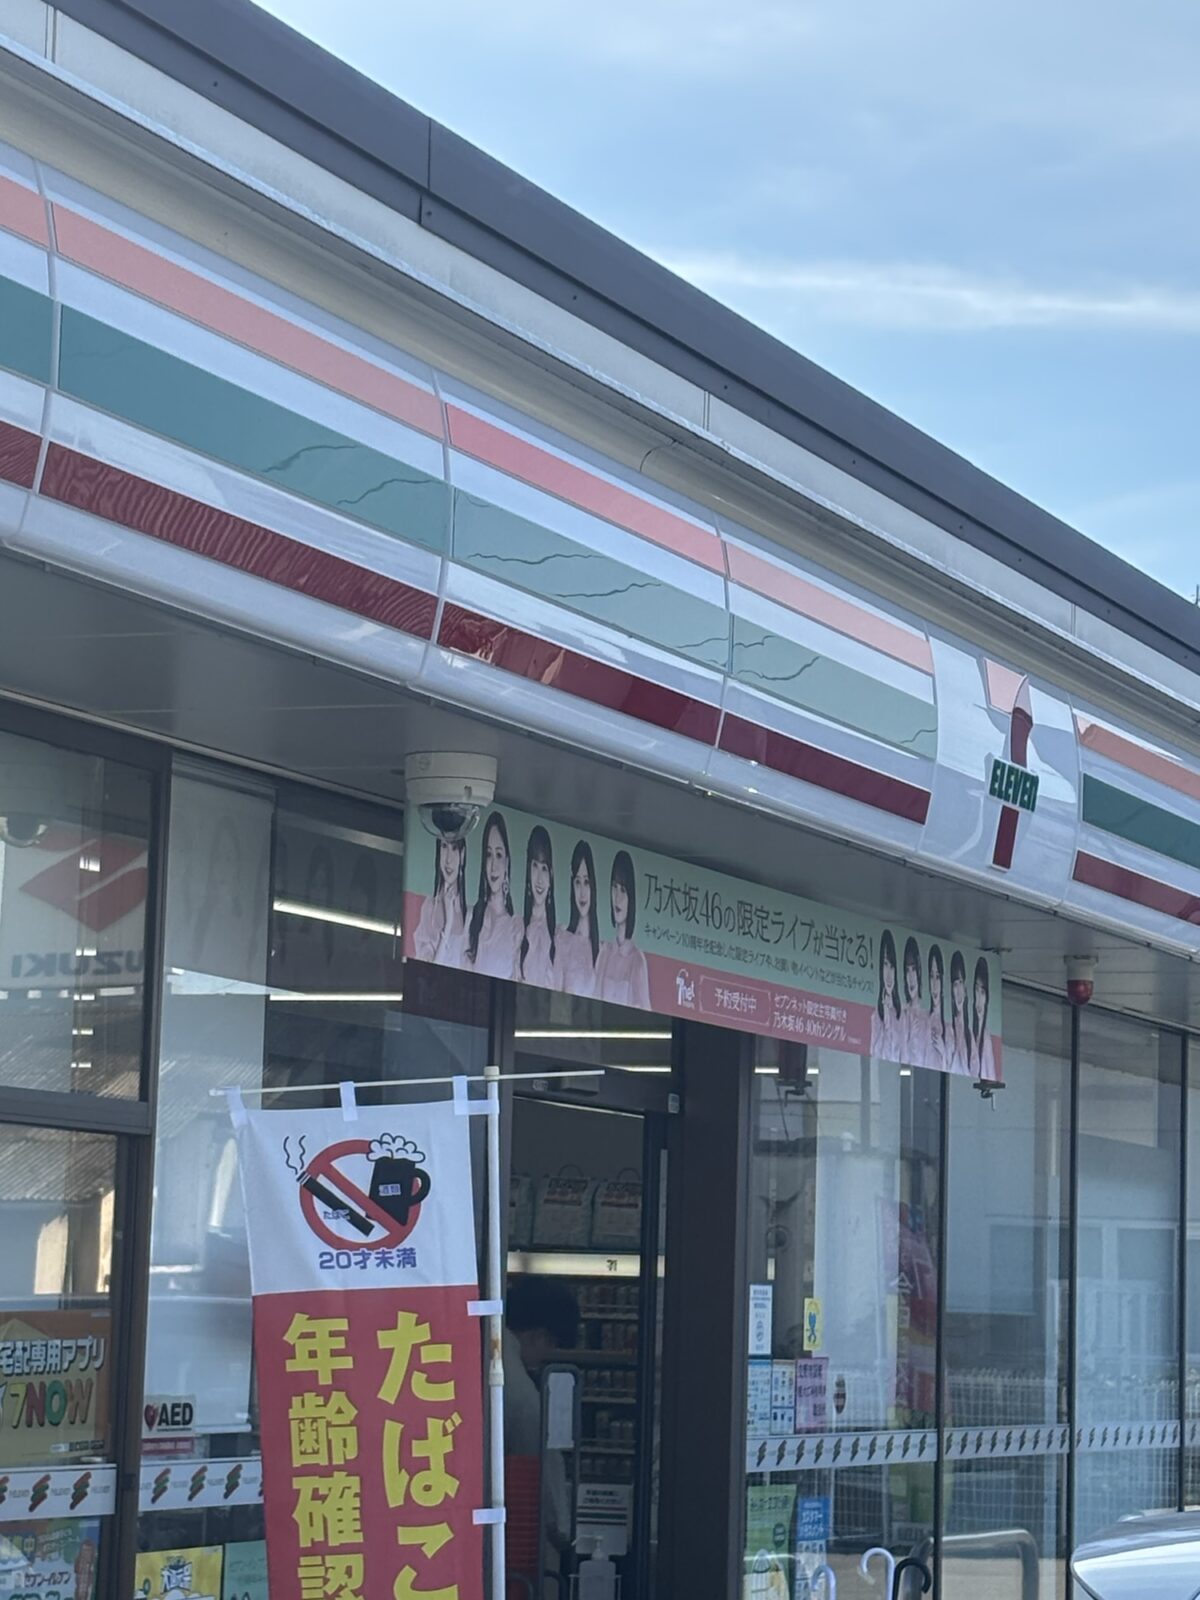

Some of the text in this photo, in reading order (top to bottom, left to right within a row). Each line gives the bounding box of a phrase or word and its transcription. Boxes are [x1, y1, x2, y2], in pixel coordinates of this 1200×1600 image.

[644, 872, 875, 971] 乃木坂46の限定ライブが当たる!
[714, 987, 757, 1014] 予約受付中
[318, 1247, 417, 1270] 20才未満
[157, 1402, 194, 1427] AED
[282, 1312, 365, 1600] 年齢確認
[376, 1310, 463, 1600] たばこ
